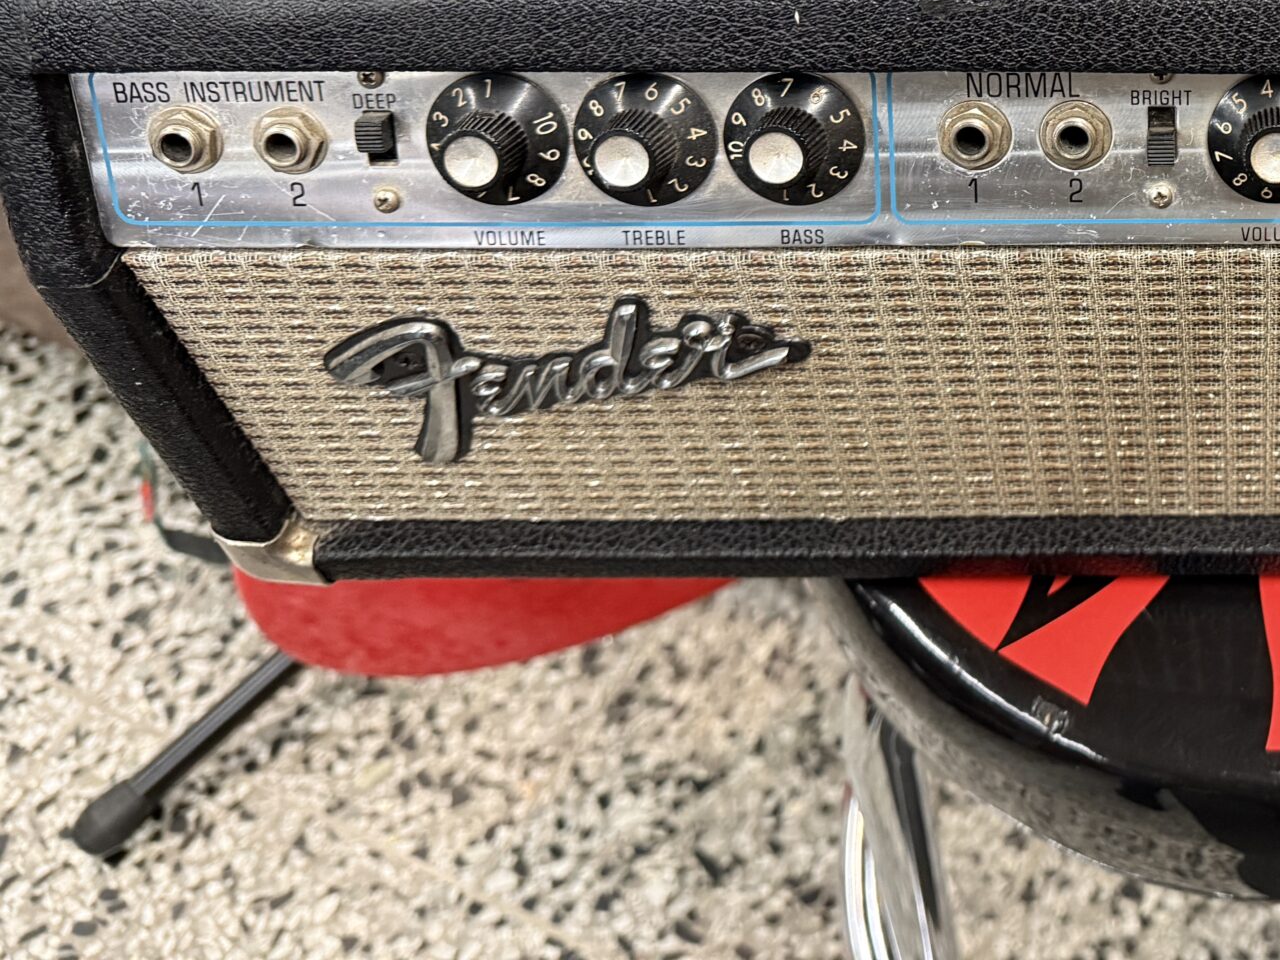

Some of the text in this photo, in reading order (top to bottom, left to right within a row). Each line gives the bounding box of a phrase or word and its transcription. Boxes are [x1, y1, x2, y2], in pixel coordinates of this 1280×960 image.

[113, 80, 326, 104] BASS INSTRUMENT
[614, 81, 626, 101] 7
[645, 82, 658, 100] 6
[778, 78, 794, 98] 7
[966, 72, 1080, 98] NORMAL
[1261, 79, 1274, 98] 4
[353, 93, 397, 110] DEEP
[452, 88, 467, 107] 2
[752, 88, 765, 106] 8
[1130, 90, 1192, 106] BRIGHT
[1232, 92, 1247, 114] 5
[589, 99, 604, 116] 8
[671, 98, 691, 115] 5
[432, 112, 448, 128] 3
[532, 112, 558, 135] 10
[732, 112, 746, 126] 9
[830, 108, 851, 123] 5
[687, 128, 708, 140] 4
[728, 141, 744, 160] 10
[838, 139, 858, 151] 4
[686, 155, 706, 168] 3
[1214, 151, 1233, 162] 7
[526, 173, 546, 186] 8
[829, 166, 848, 179] 3
[1232, 173, 1248, 186] 8
[667, 178, 688, 192] 2
[807, 183, 824, 198] 2
[968, 178, 978, 204] 1
[1069, 178, 1083, 203] 2
[191, 182, 204, 207] 1
[290, 182, 307, 207] 2
[474, 230, 546, 246] VOLUME
[622, 230, 687, 246] TREBLE
[781, 229, 824, 245] BASS
[323, 294, 812, 464] Fender
